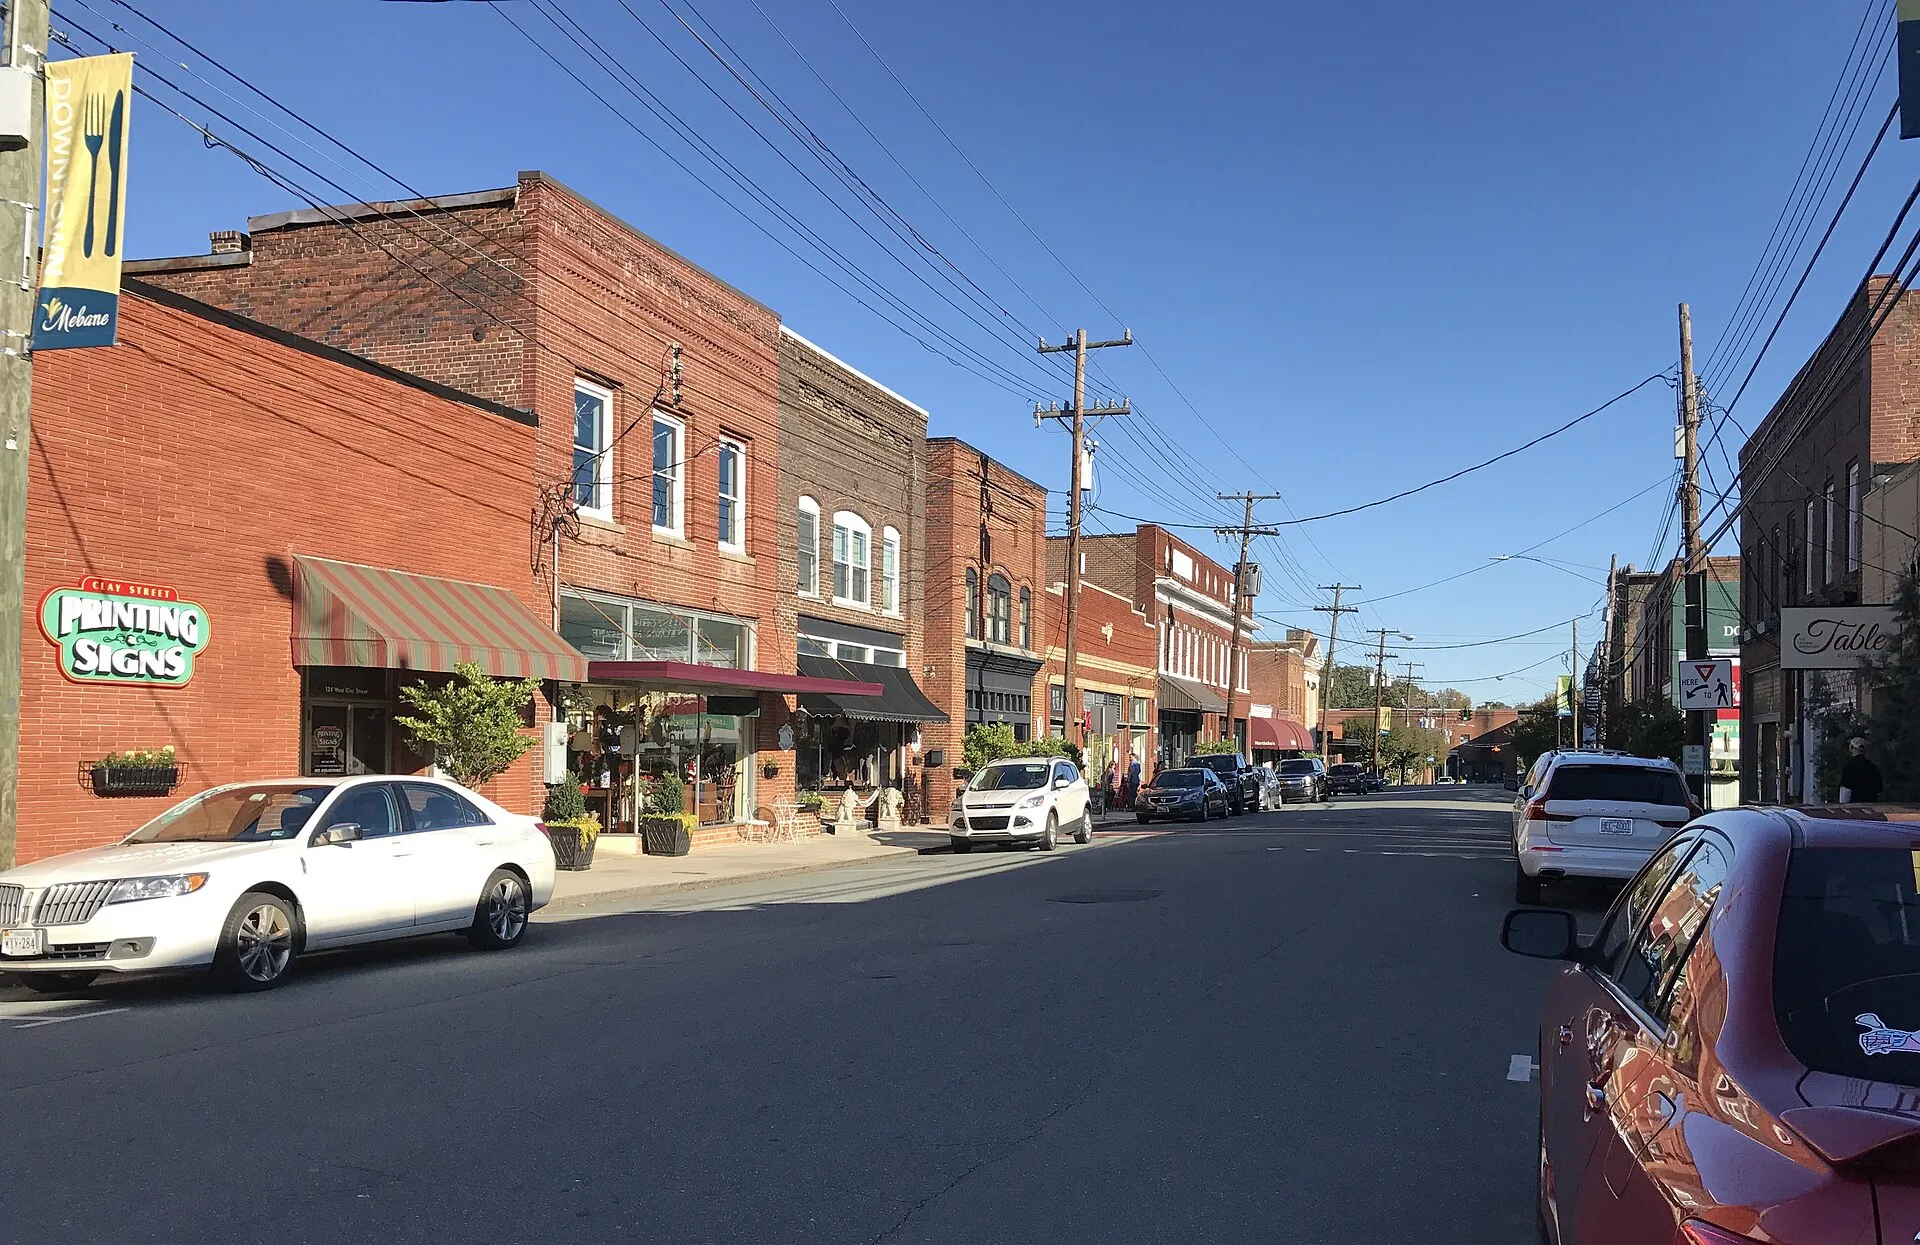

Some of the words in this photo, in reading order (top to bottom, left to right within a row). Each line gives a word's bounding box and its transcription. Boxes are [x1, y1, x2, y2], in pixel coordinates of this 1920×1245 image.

[42, 303, 110, 333] Mebane
[92, 581, 121, 593] CLAY
[129, 585, 170, 599] STREET
[58, 595, 199, 648] PRINTING
[1793, 617, 1887, 655] Table
[71, 637, 186, 680] SIGNS
[1704, 691, 1712, 699] TO
[317, 730, 340, 738] PRINTING
